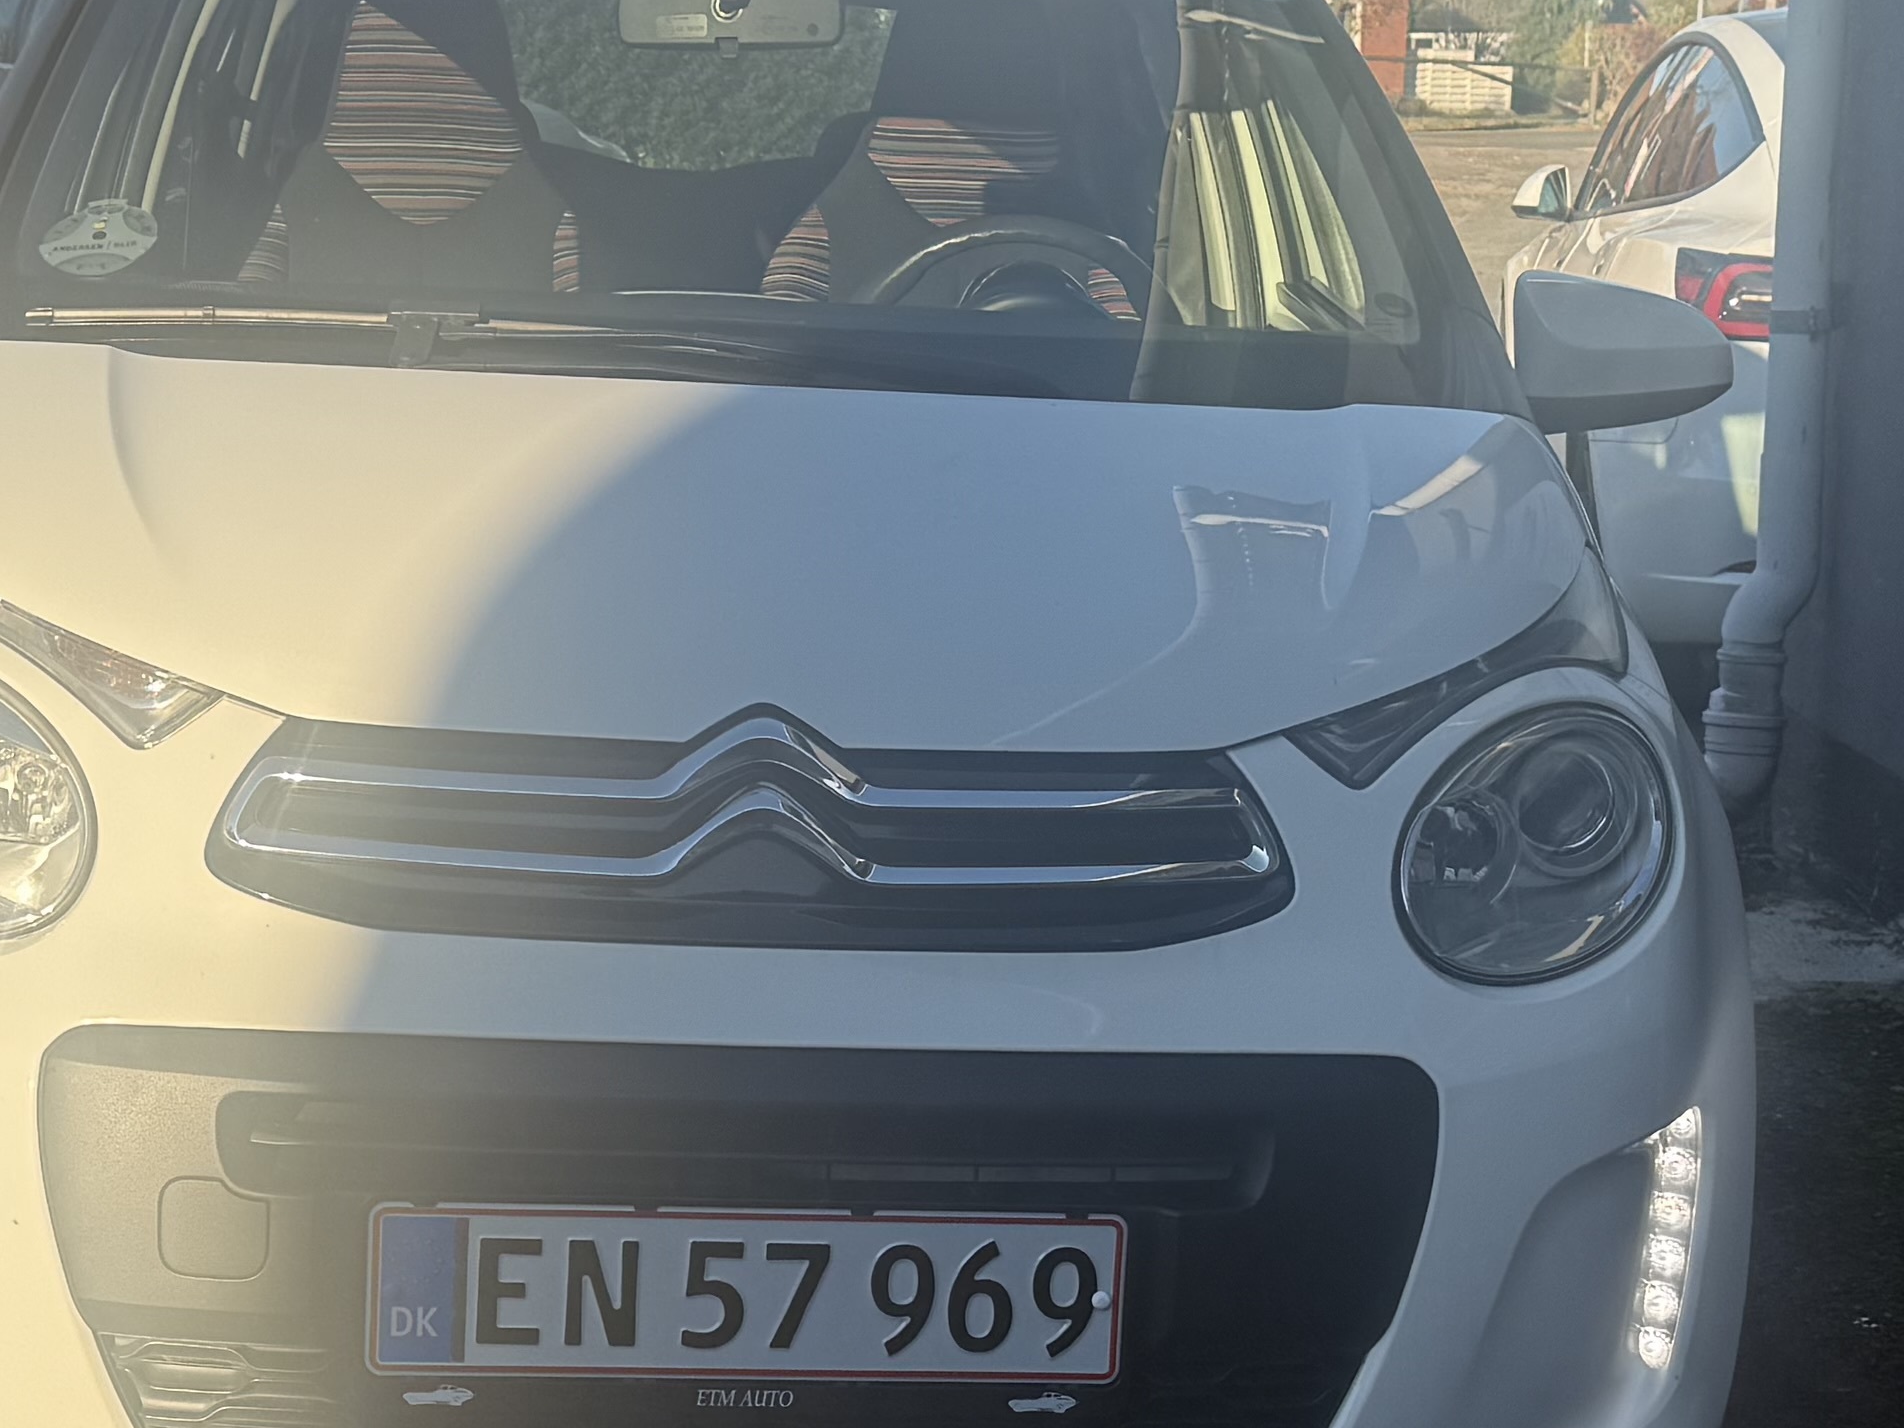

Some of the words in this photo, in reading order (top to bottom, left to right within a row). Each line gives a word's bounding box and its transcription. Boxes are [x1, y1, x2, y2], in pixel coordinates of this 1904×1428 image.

[389, 1306, 439, 1340] DK
[475, 1237, 640, 1348] EN
[680, 1240, 832, 1350] 57
[870, 1239, 1098, 1358] 969
[696, 1388, 737, 1407] ETM
[739, 1389, 794, 1408] AUTO
